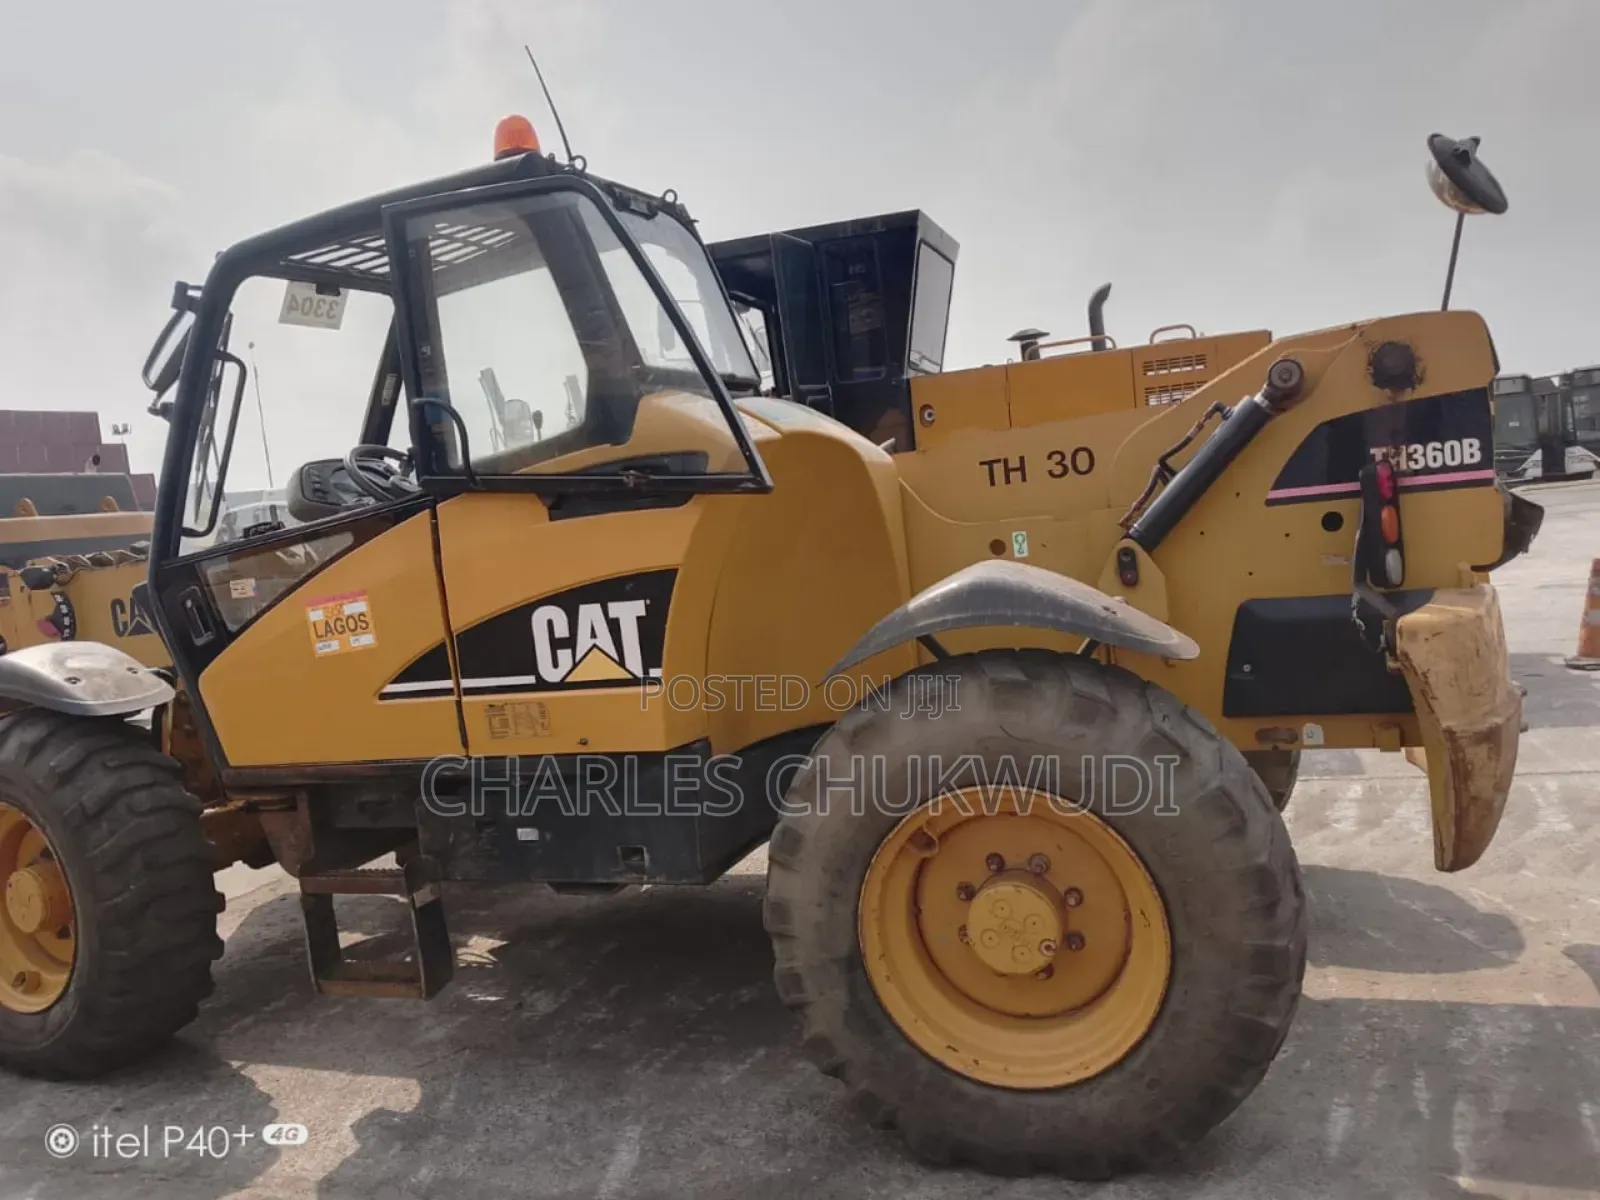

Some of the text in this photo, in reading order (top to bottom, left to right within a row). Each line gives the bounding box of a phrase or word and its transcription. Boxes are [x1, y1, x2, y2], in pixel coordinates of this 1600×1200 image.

[979, 446, 1096, 487] TH 30
[312, 612, 370, 639] LAGOS
[531, 600, 647, 683] CAT
